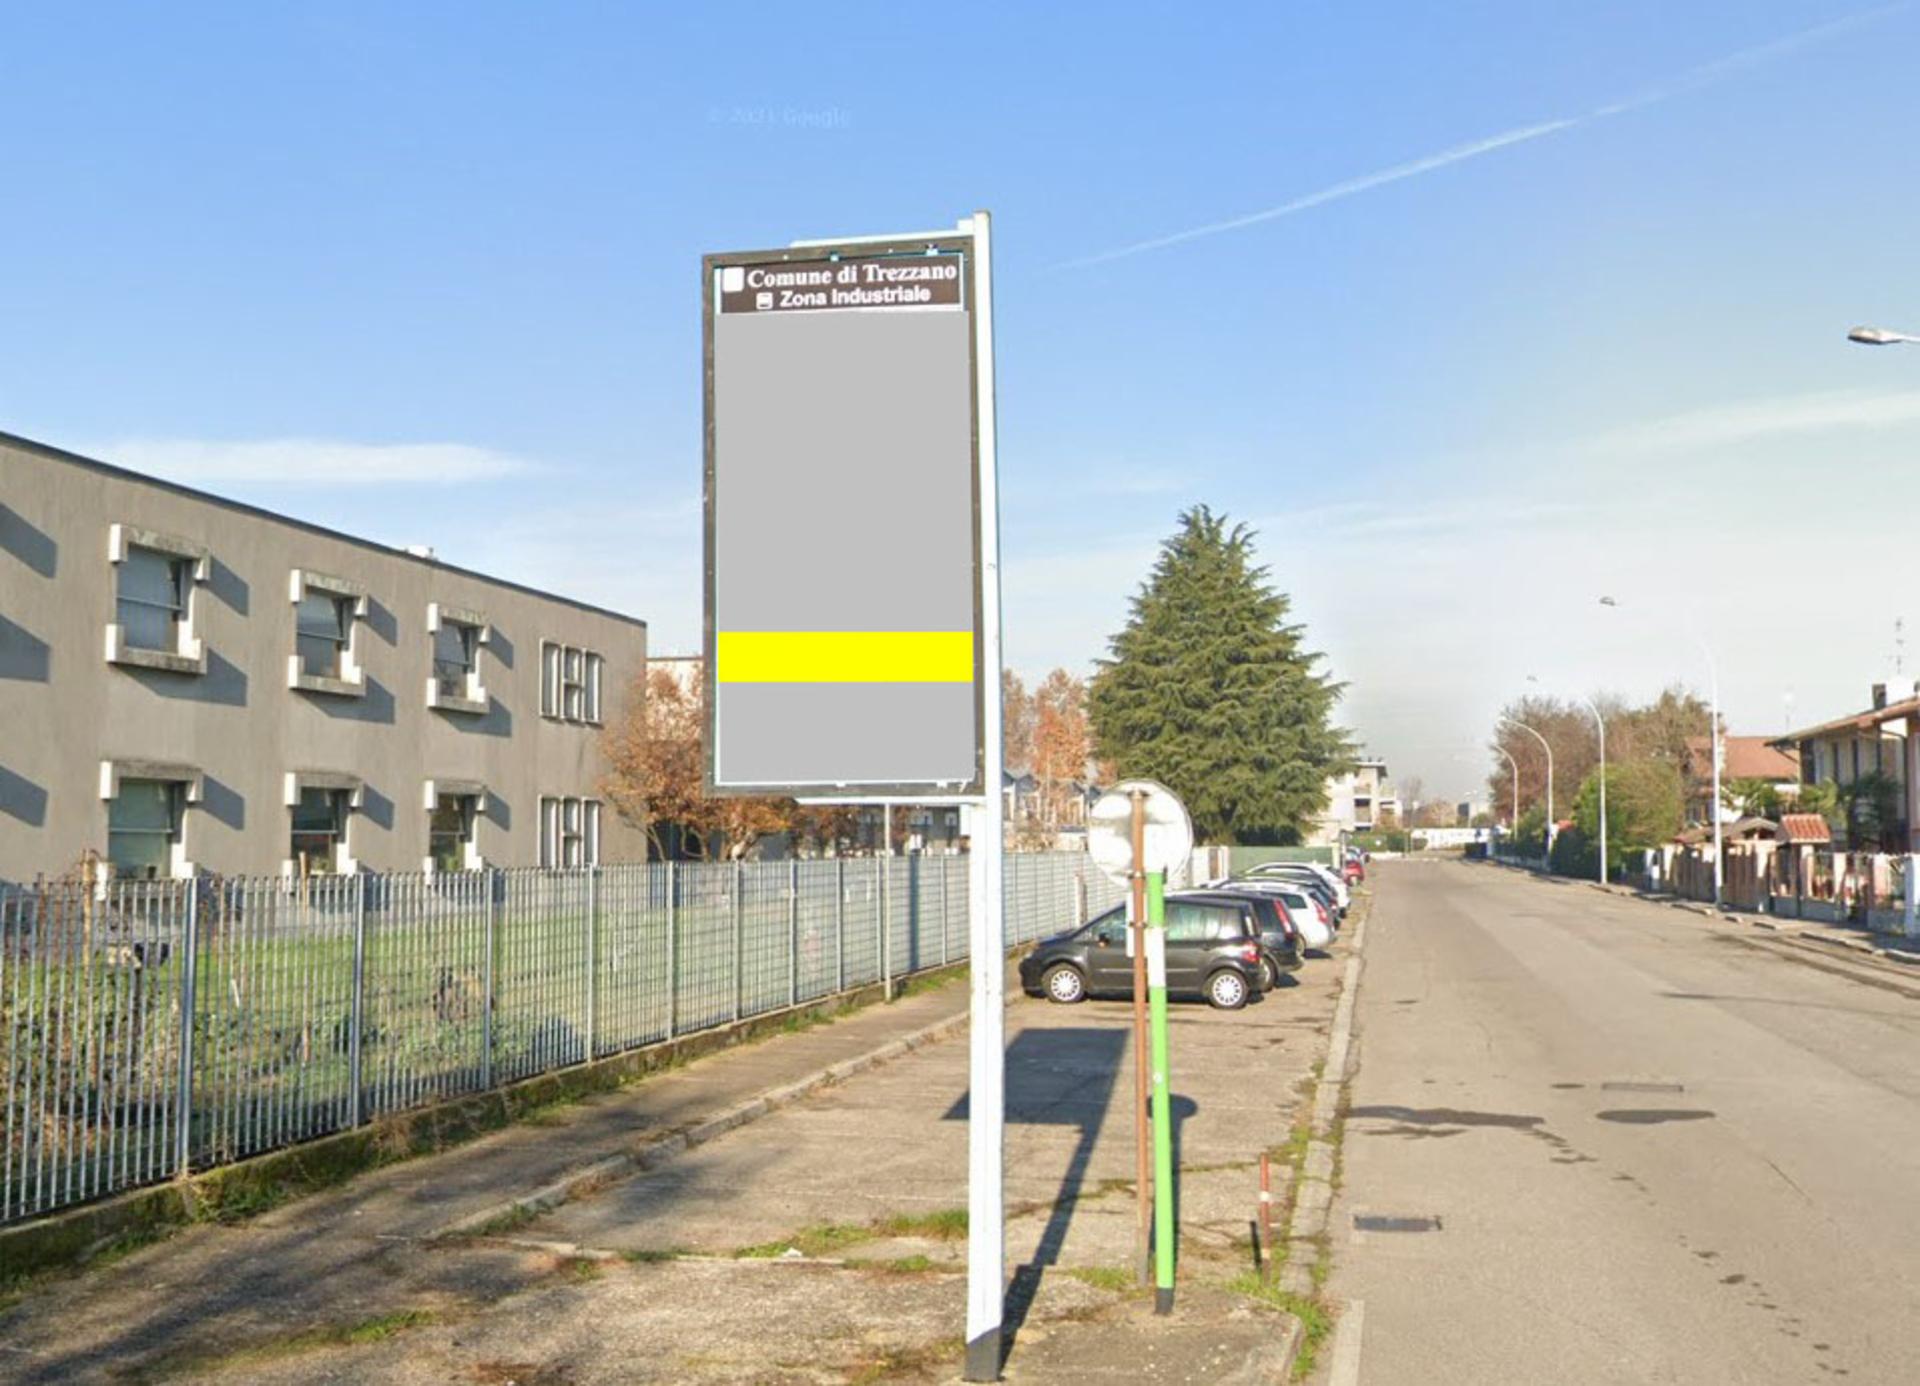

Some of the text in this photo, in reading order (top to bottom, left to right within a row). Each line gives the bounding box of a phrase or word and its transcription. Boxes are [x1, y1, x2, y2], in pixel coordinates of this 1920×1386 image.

[747, 262, 958, 288] Comune di Trezzano
[779, 289, 828, 308] Zona
